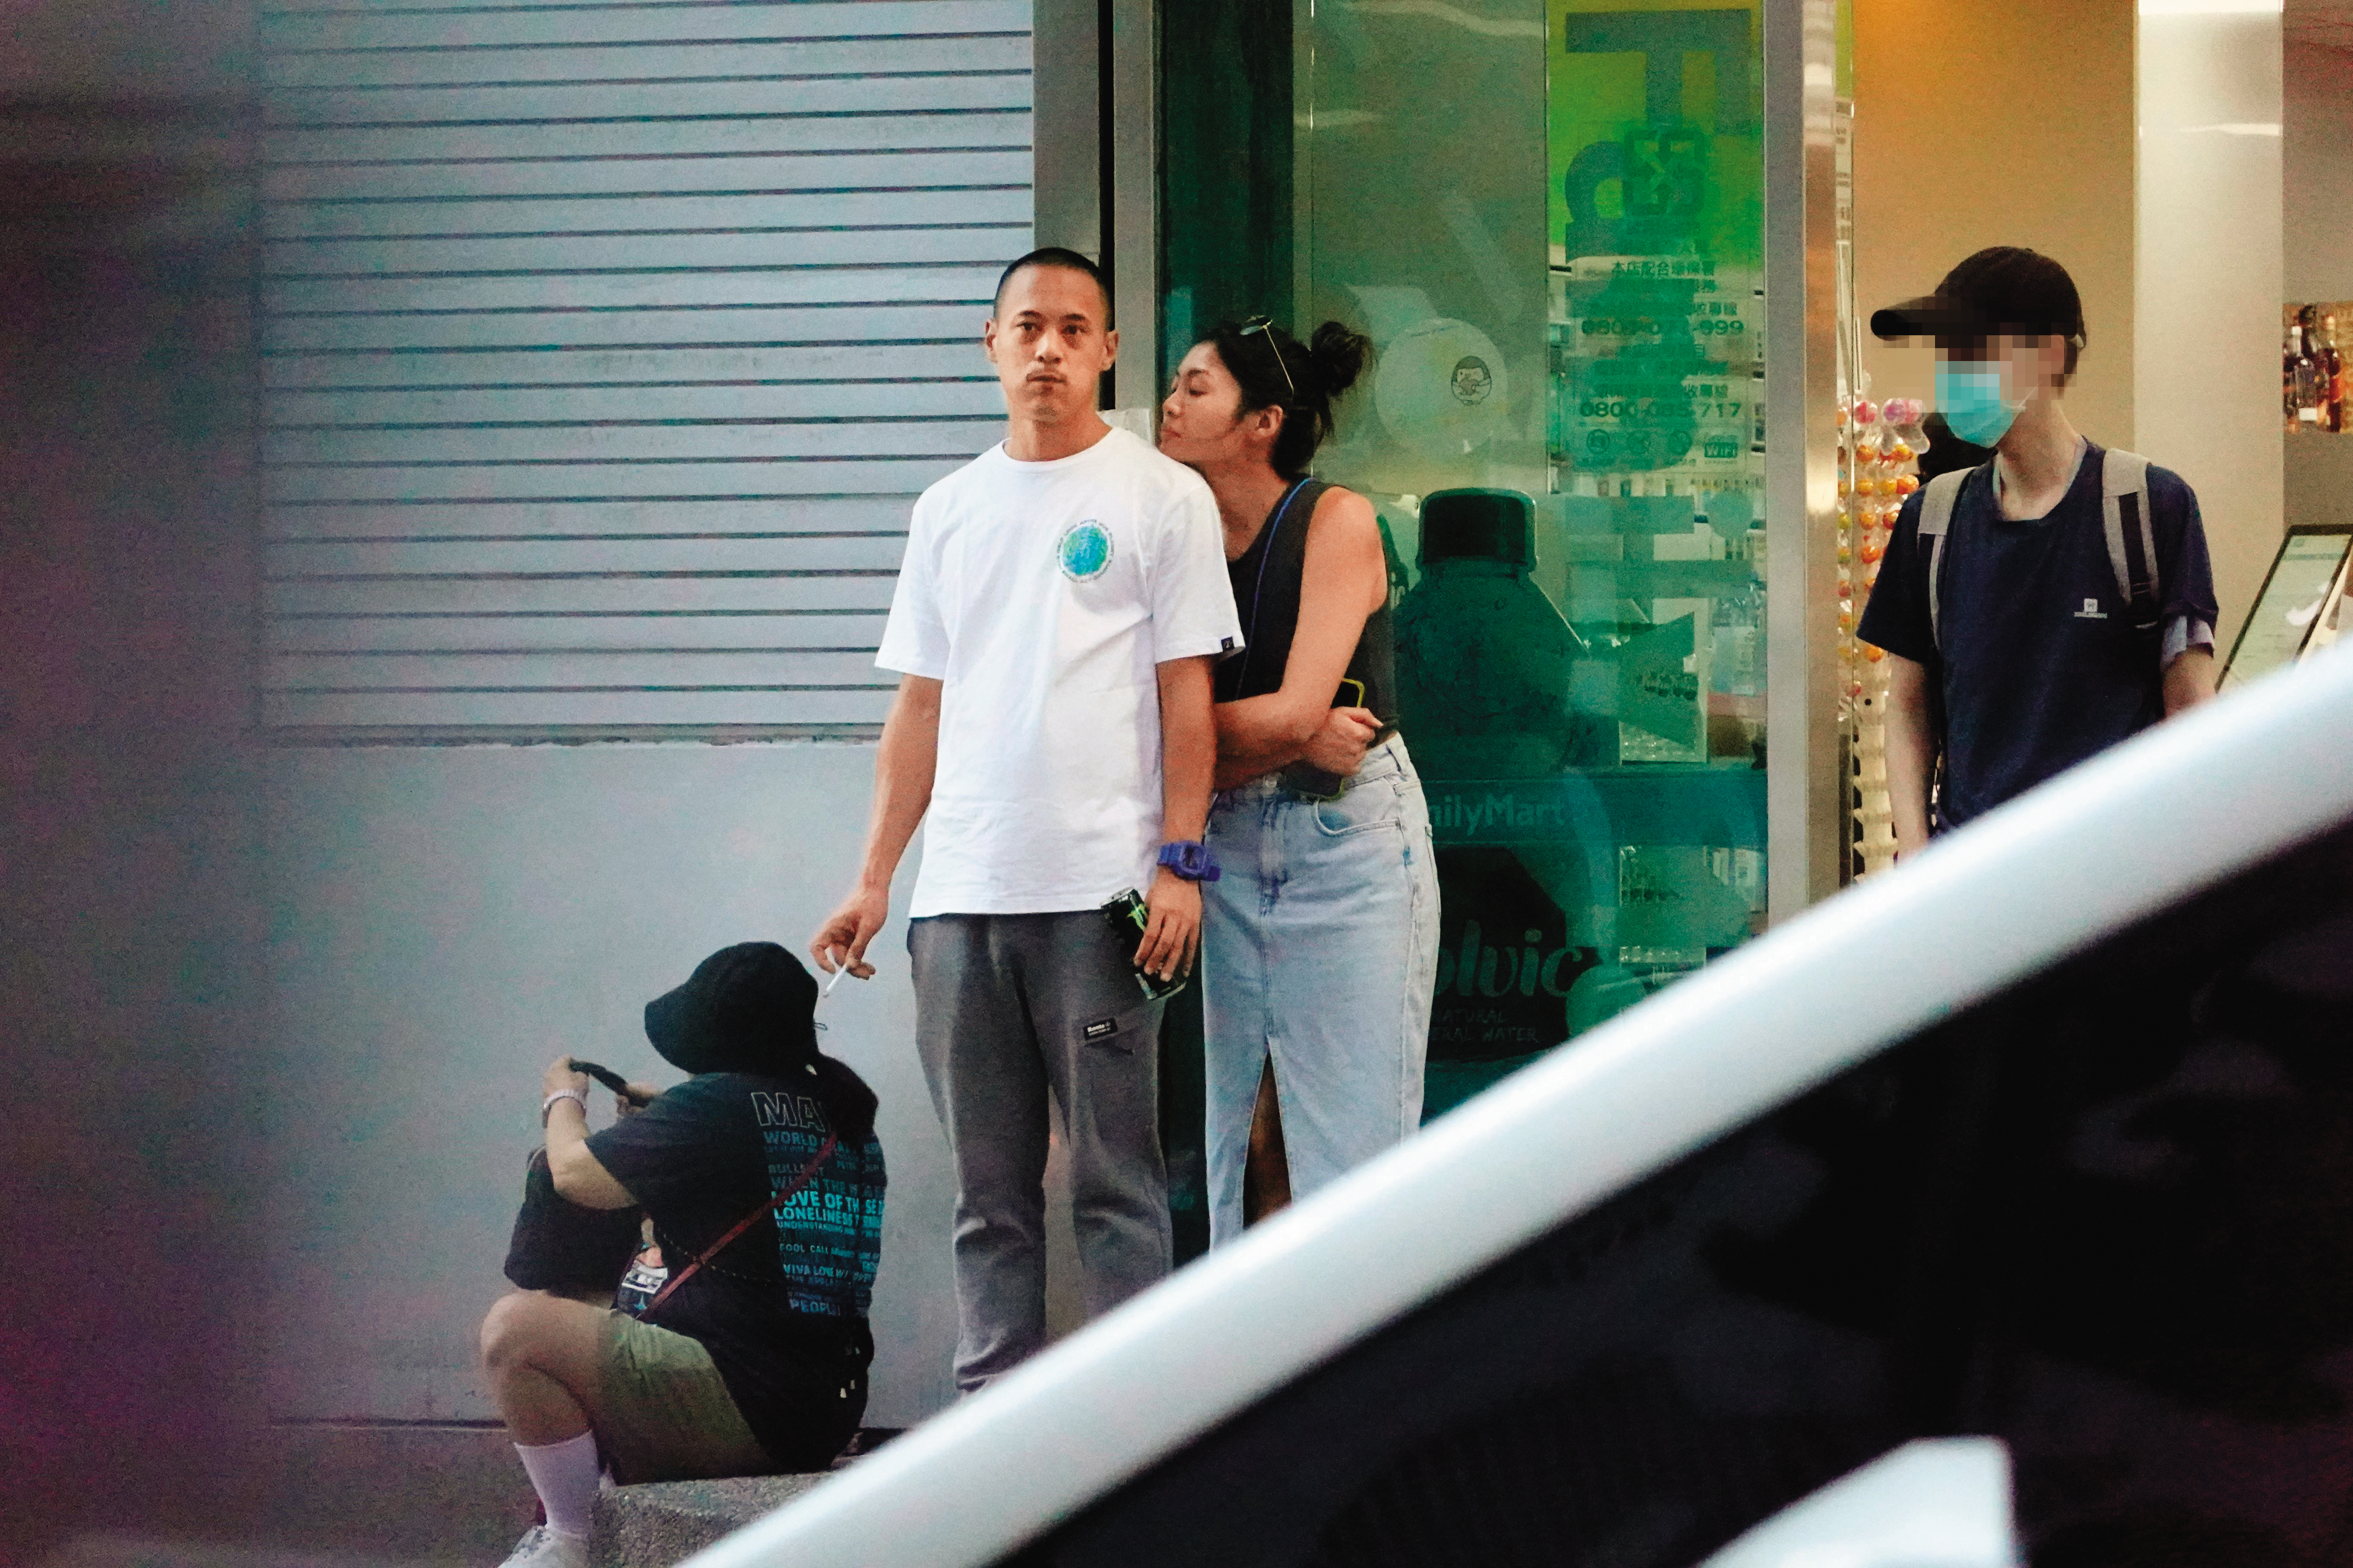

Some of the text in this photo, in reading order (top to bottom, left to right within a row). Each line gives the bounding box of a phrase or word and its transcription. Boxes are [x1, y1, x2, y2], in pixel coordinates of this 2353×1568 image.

[763, 1131, 817, 1147] WORLD
[824, 1192, 843, 1210] OF
[773, 1207, 853, 1227] LONELINESS
[782, 1263, 811, 1276] VIVA
[788, 1298, 841, 1317] PEOPL
